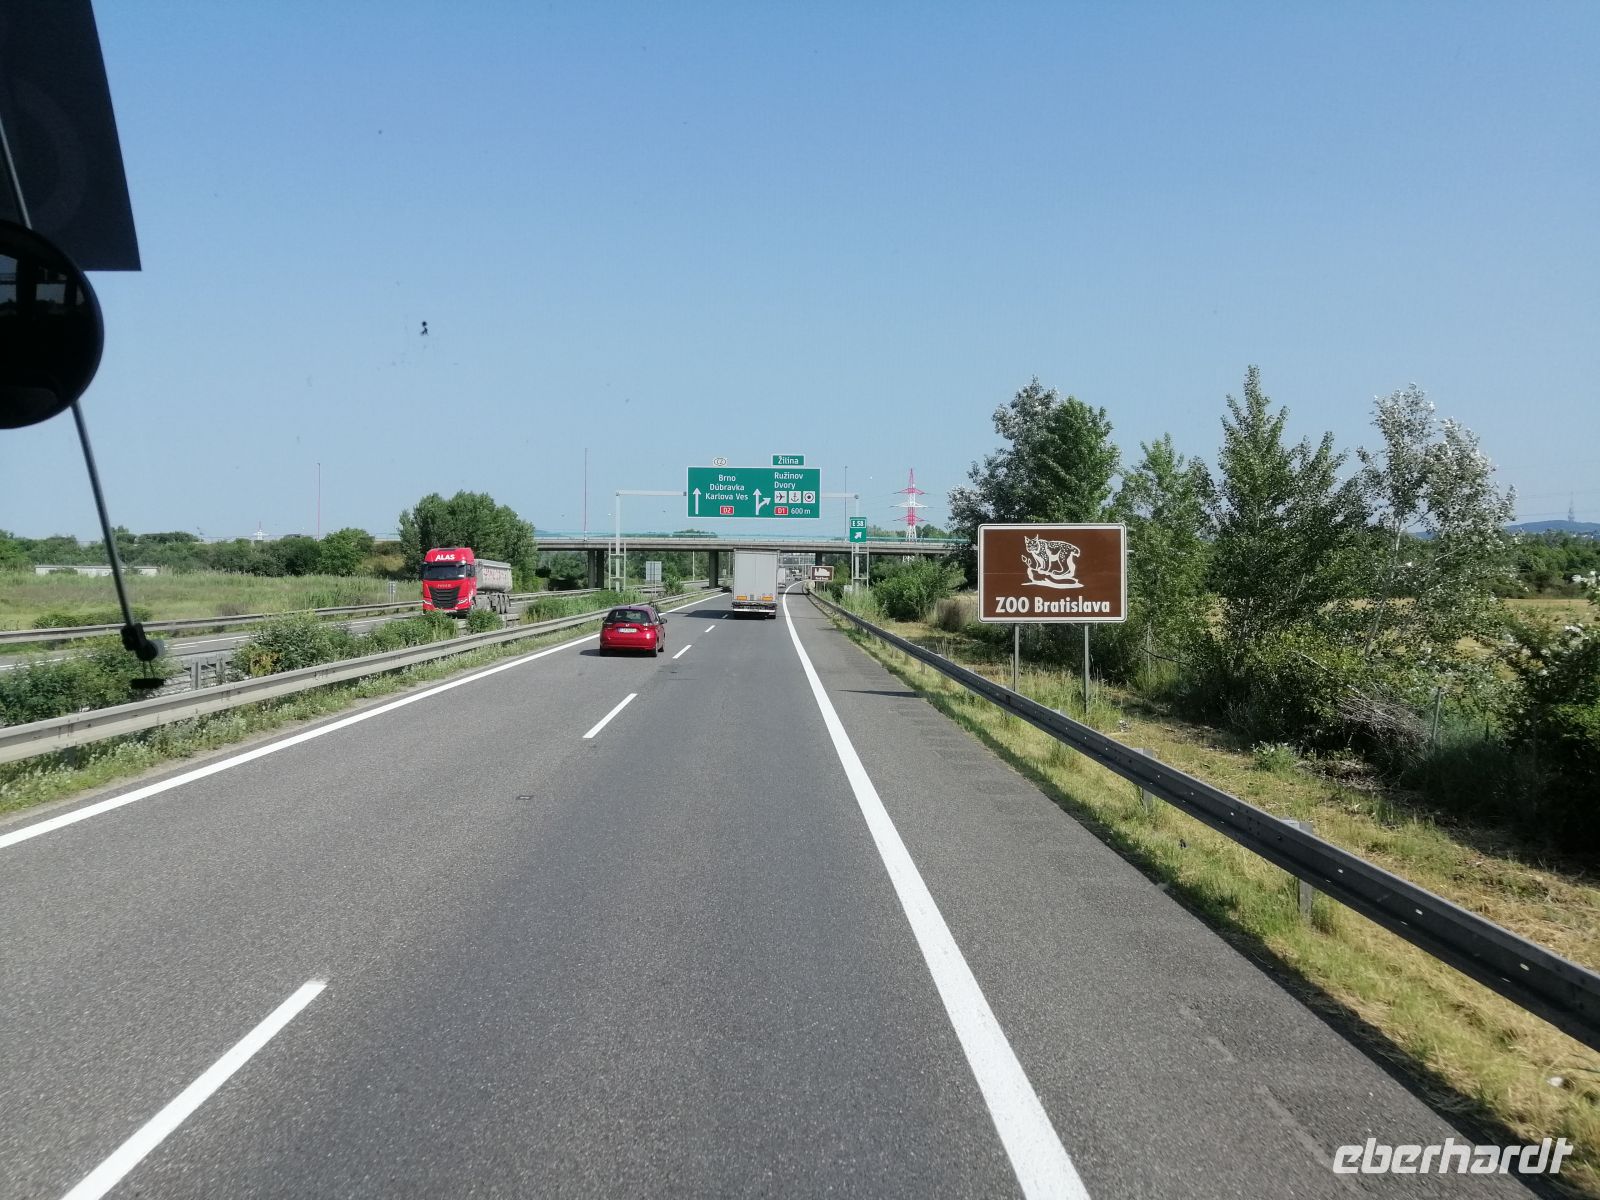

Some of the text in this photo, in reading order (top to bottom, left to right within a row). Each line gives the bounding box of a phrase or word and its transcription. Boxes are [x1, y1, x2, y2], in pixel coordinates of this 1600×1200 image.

[777, 455, 799, 465] Žilina
[709, 482, 745, 491] Dúbravka
[774, 481, 795, 489] Dvory
[705, 492, 749, 500] Karlova Ves
[790, 507, 803, 515] 600
[995, 595, 1110, 614] ZOO Bratislava
